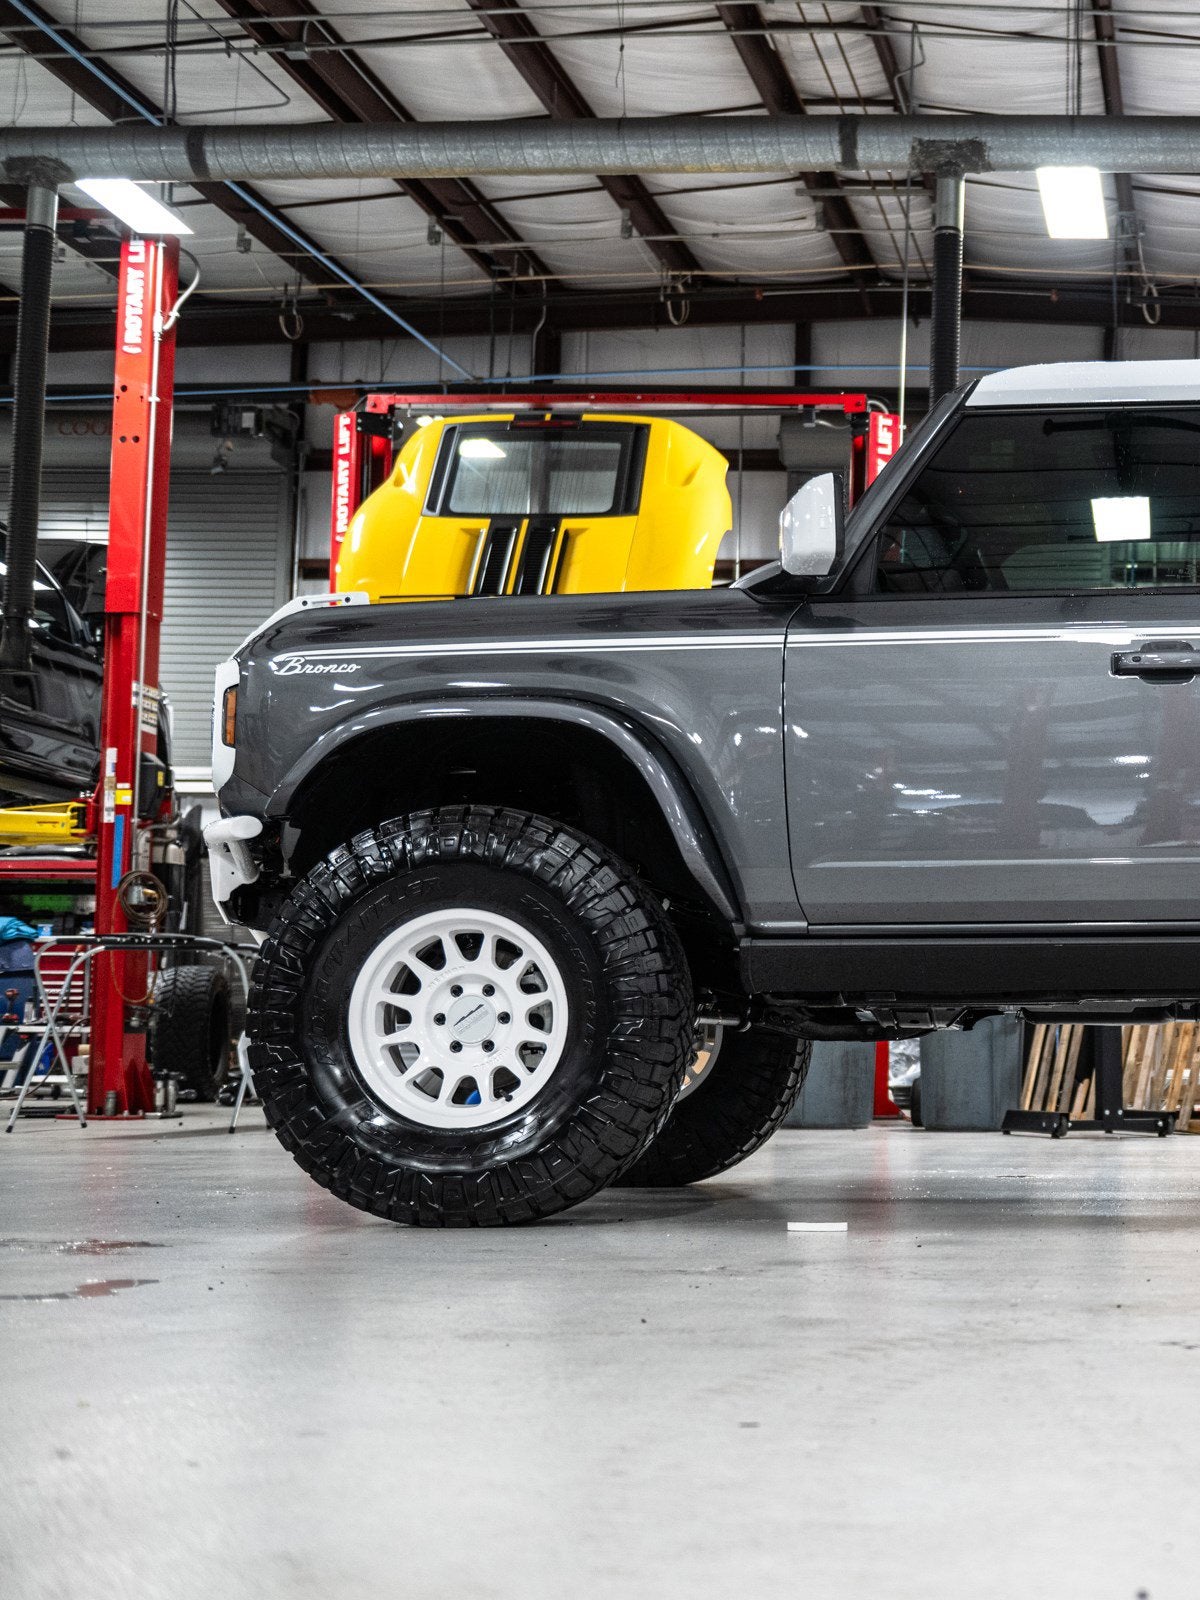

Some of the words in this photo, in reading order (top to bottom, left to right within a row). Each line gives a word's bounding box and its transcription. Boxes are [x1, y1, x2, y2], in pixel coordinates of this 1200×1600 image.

[124, 266, 144, 343] ROTARY
[338, 413, 351, 456] LIFT
[877, 414, 893, 455] LIFT
[336, 459, 350, 534] ROTARY
[274, 656, 361, 676] Bronco
